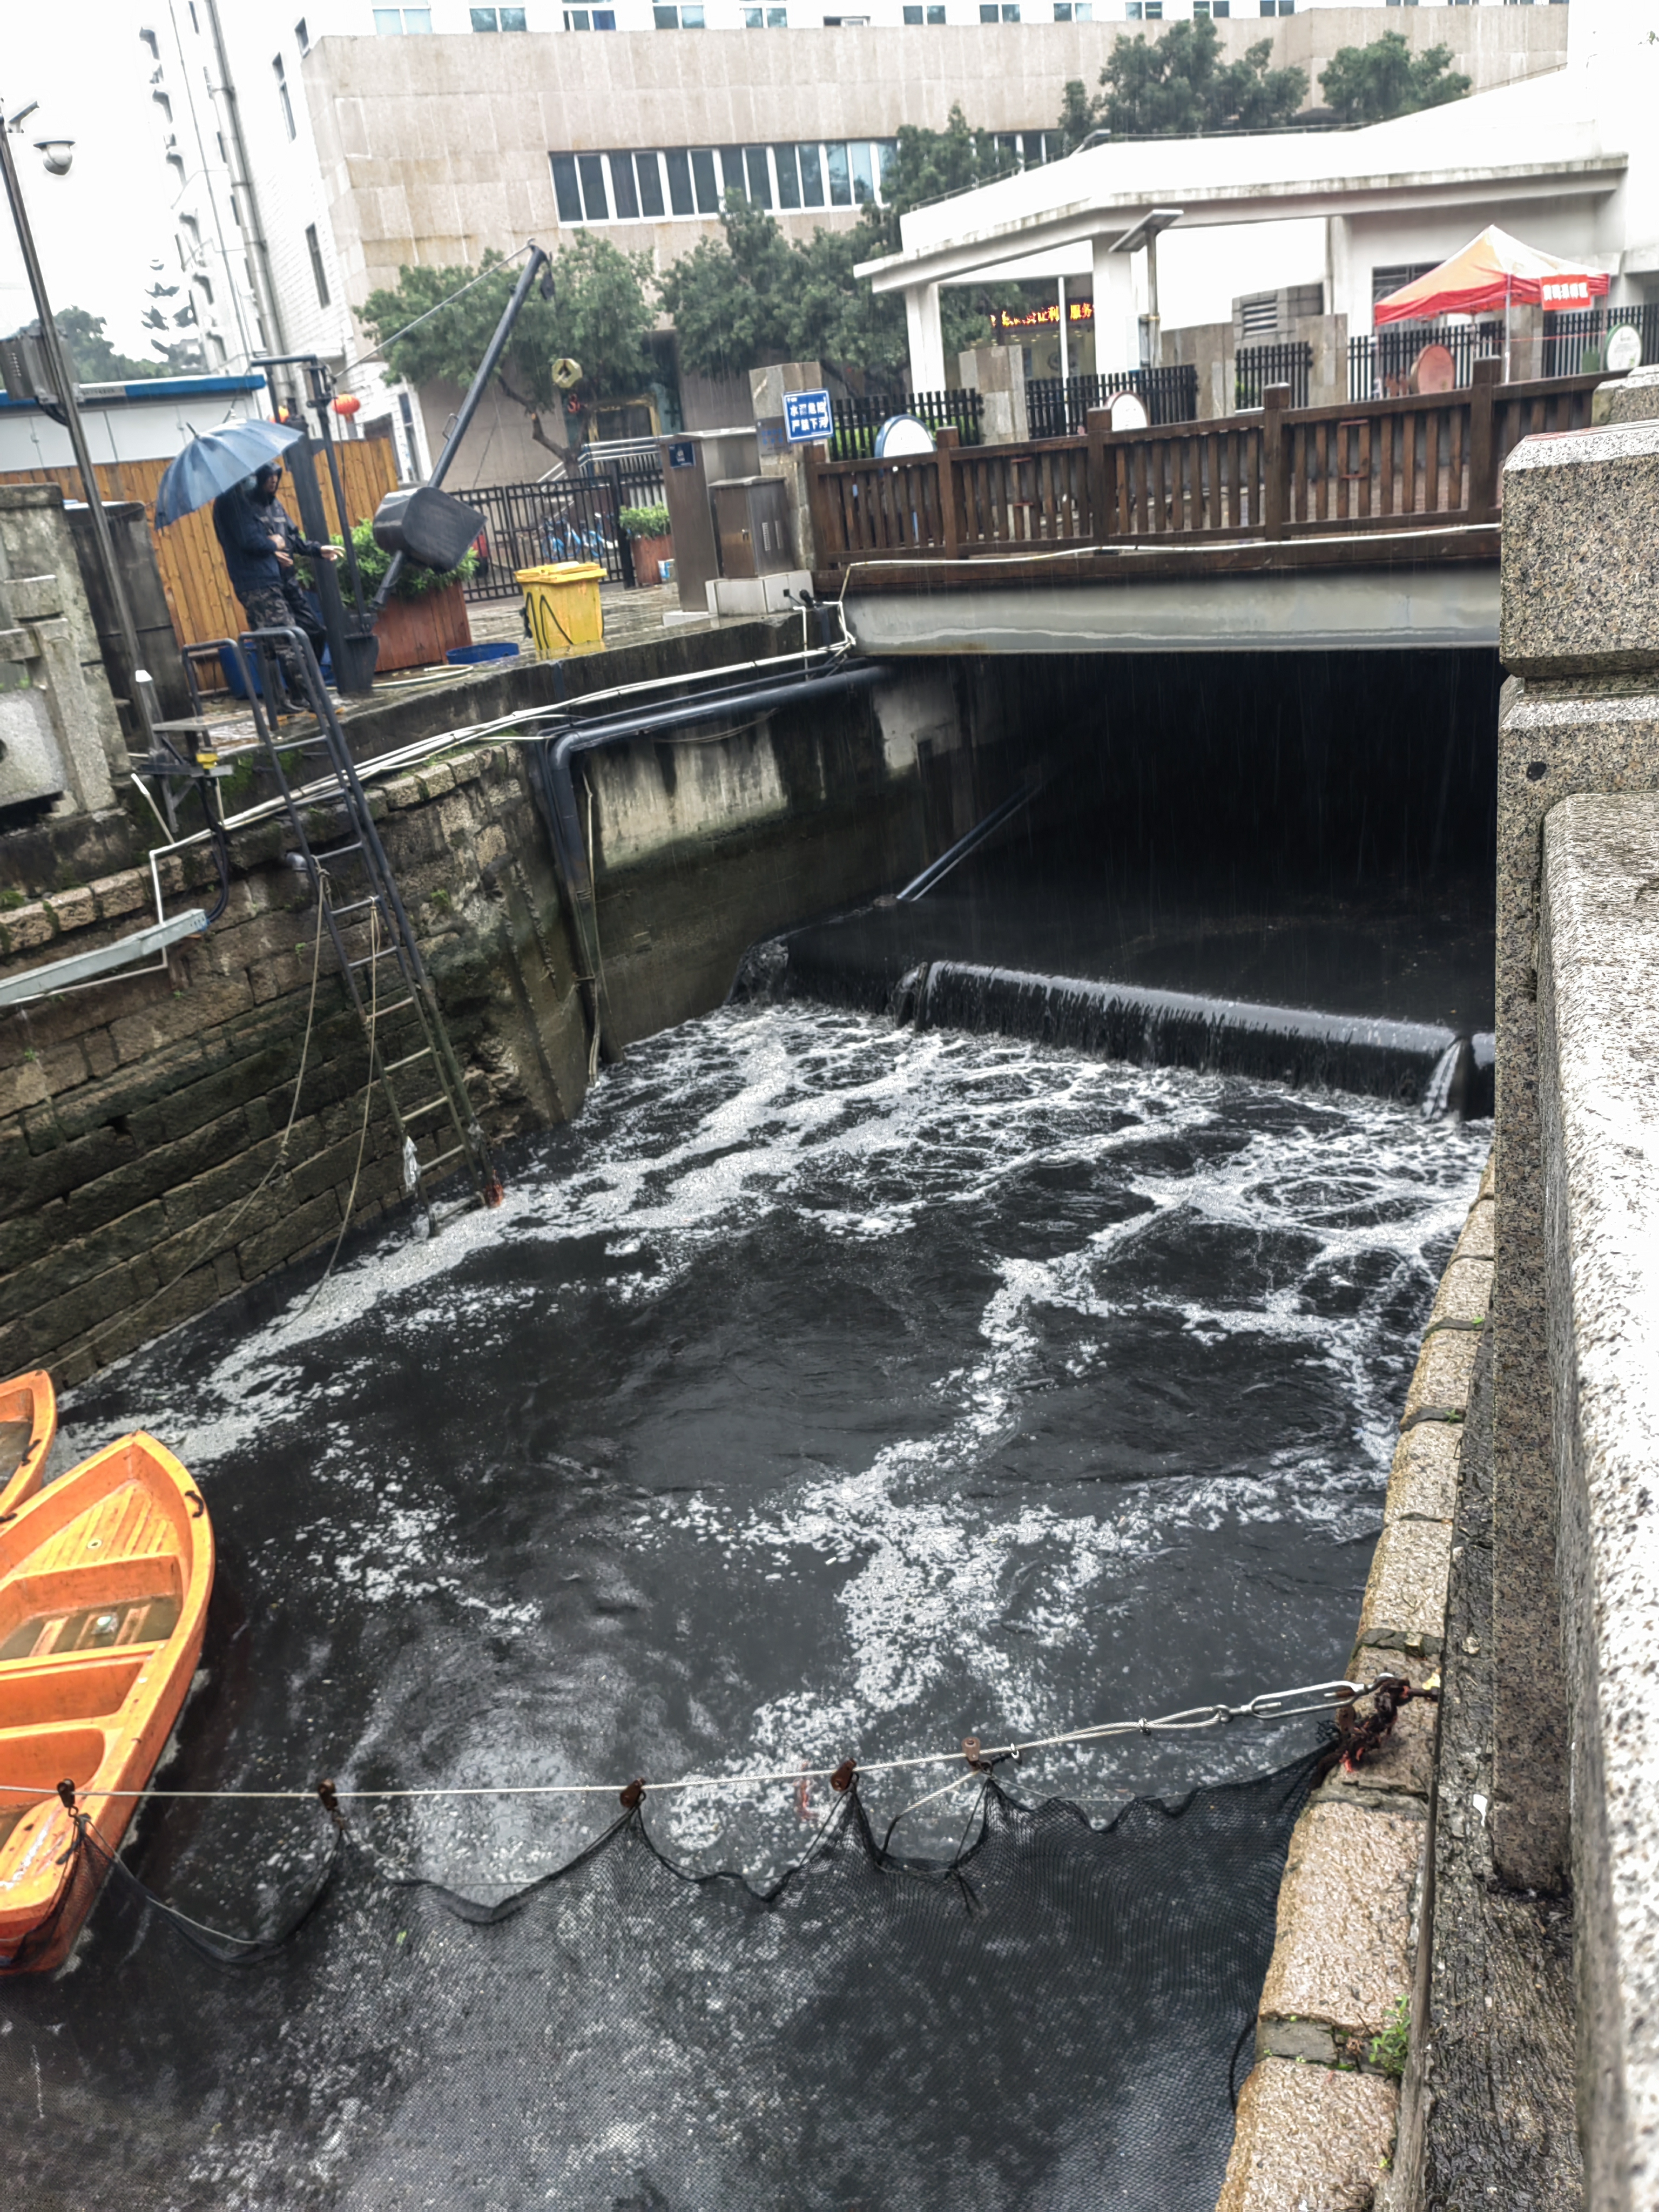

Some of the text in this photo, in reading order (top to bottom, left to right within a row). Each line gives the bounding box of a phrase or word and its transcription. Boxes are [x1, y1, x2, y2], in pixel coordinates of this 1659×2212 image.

[790, 402, 827, 417] 水深危险
[792, 416, 828, 432] 严禁下河
